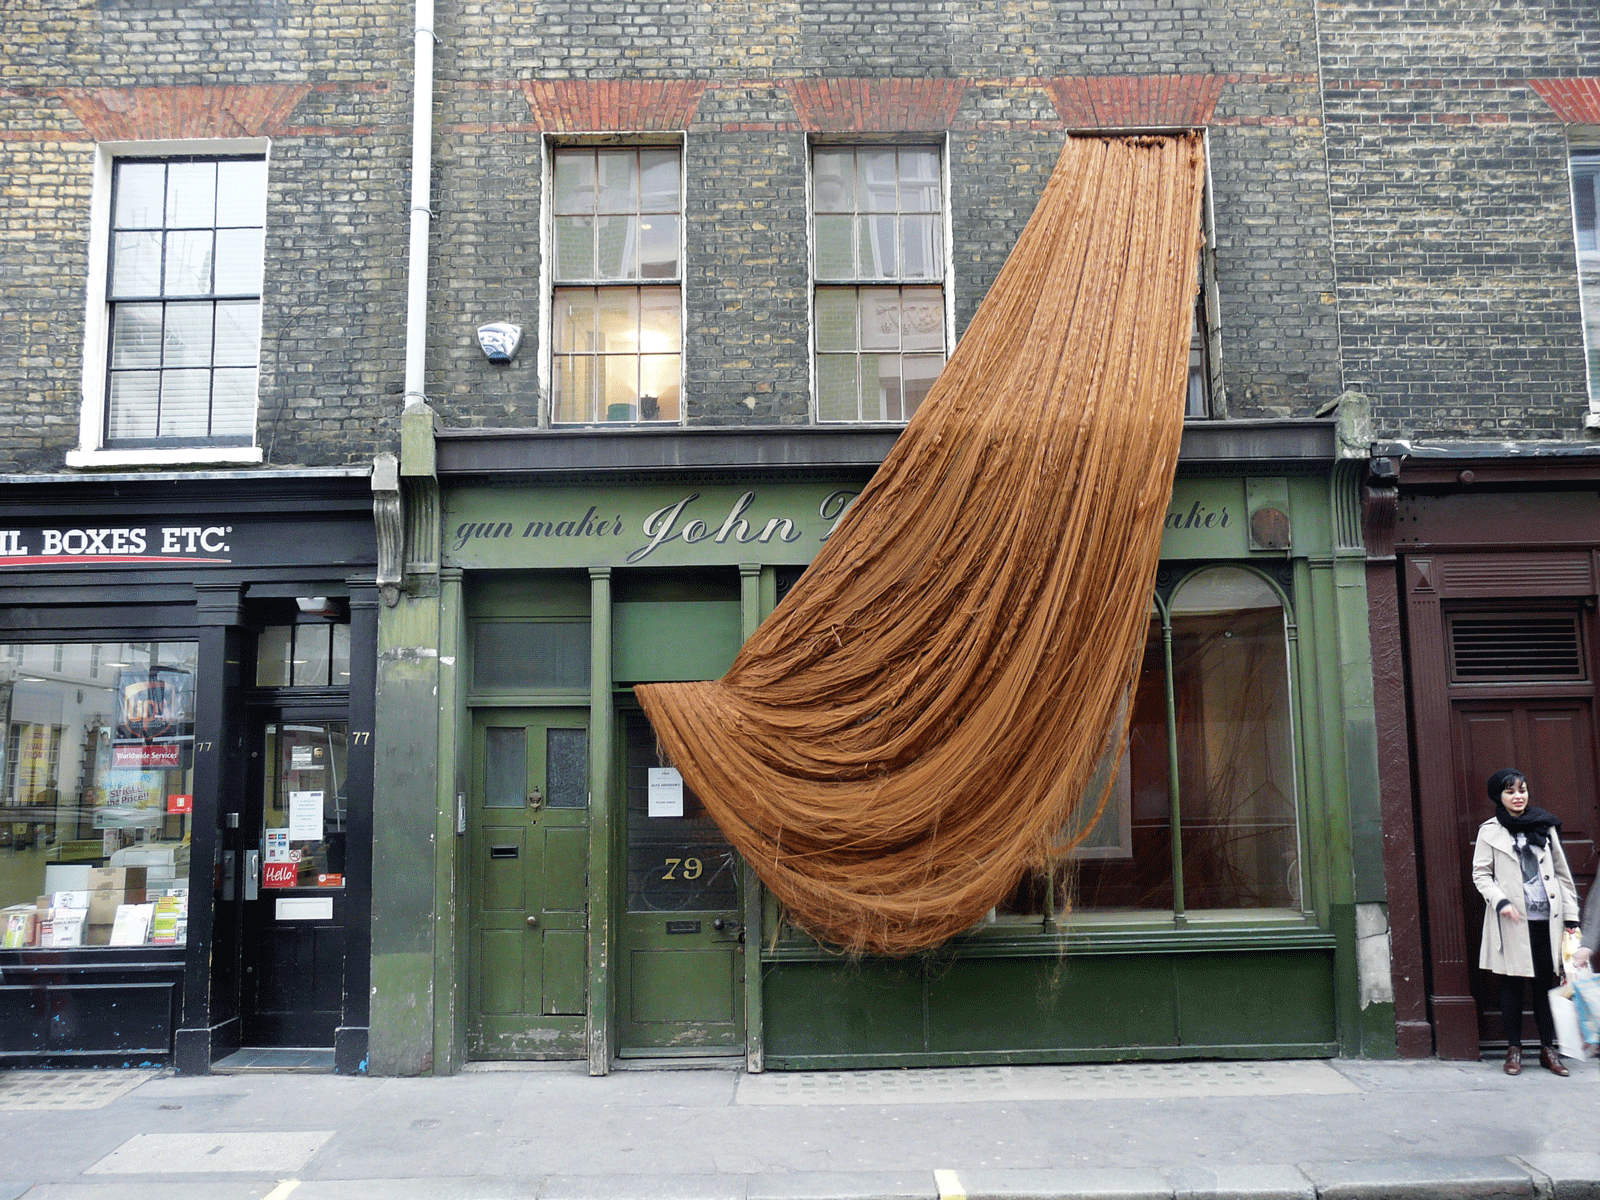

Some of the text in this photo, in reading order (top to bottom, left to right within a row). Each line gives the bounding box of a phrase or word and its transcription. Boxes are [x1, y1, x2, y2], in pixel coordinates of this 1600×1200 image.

[1164, 501, 1233, 529] aker
[452, 522, 514, 551] gun
[522, 505, 625, 538] maker
[624, 490, 802, 564] John
[42, 528, 147, 555] BOXES
[197, 742, 212, 752] 77
[352, 731, 370, 746] 77
[116, 751, 178, 759] Worldwide Services
[110, 786, 143, 798] SINGLE
[661, 857, 703, 880] 79
